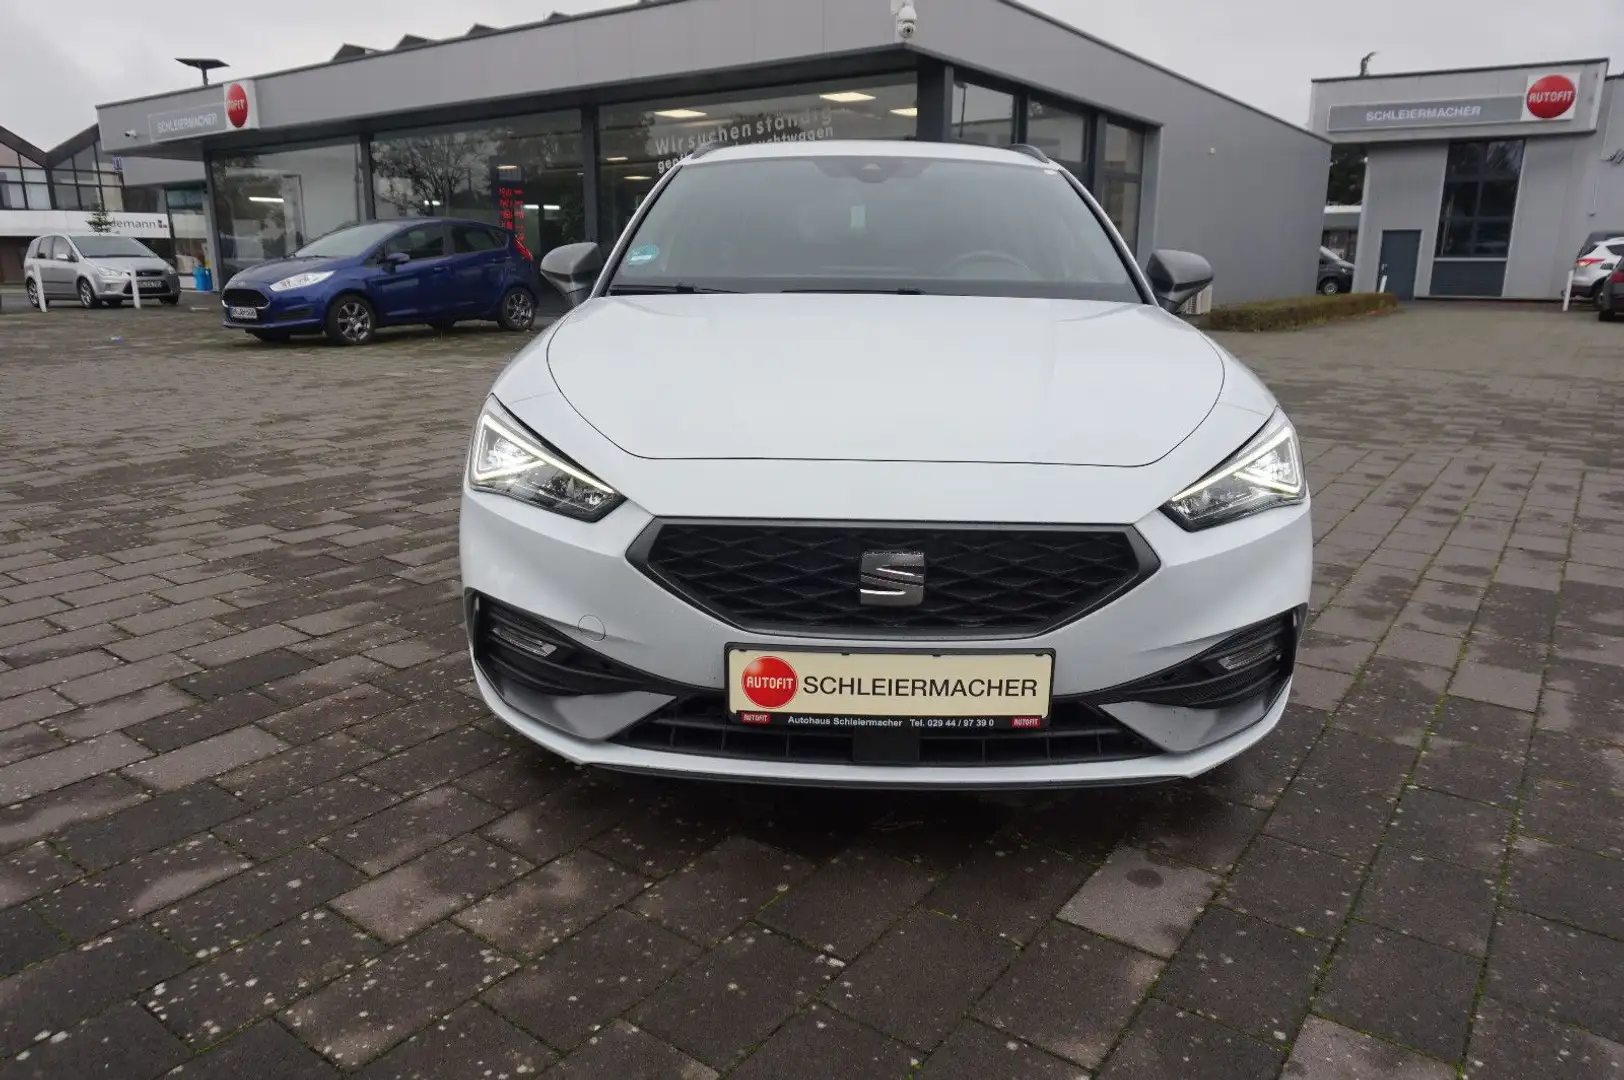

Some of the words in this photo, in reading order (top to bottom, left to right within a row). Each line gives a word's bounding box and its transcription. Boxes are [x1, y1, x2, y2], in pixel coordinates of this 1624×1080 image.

[1528, 90, 1573, 103] AUTOFIT
[1366, 105, 1481, 122] SCHLEIERMACHER
[746, 676, 794, 689] AUTOFIT
[803, 675, 1037, 697] SCHLEIERMACHER
[743, 713, 768, 722] AUTOFIT
[787, 716, 830, 725] Autohaus
[833, 716, 902, 727] Schleiermacher
[910, 719, 925, 727] Tel.
[927, 719, 943, 727] 029
[945, 719, 956, 727] 44
[963, 719, 974, 727] 97
[976, 719, 986, 727] 39
[988, 719, 994, 727] 0
[1013, 718, 1039, 727] AUTOFIT
